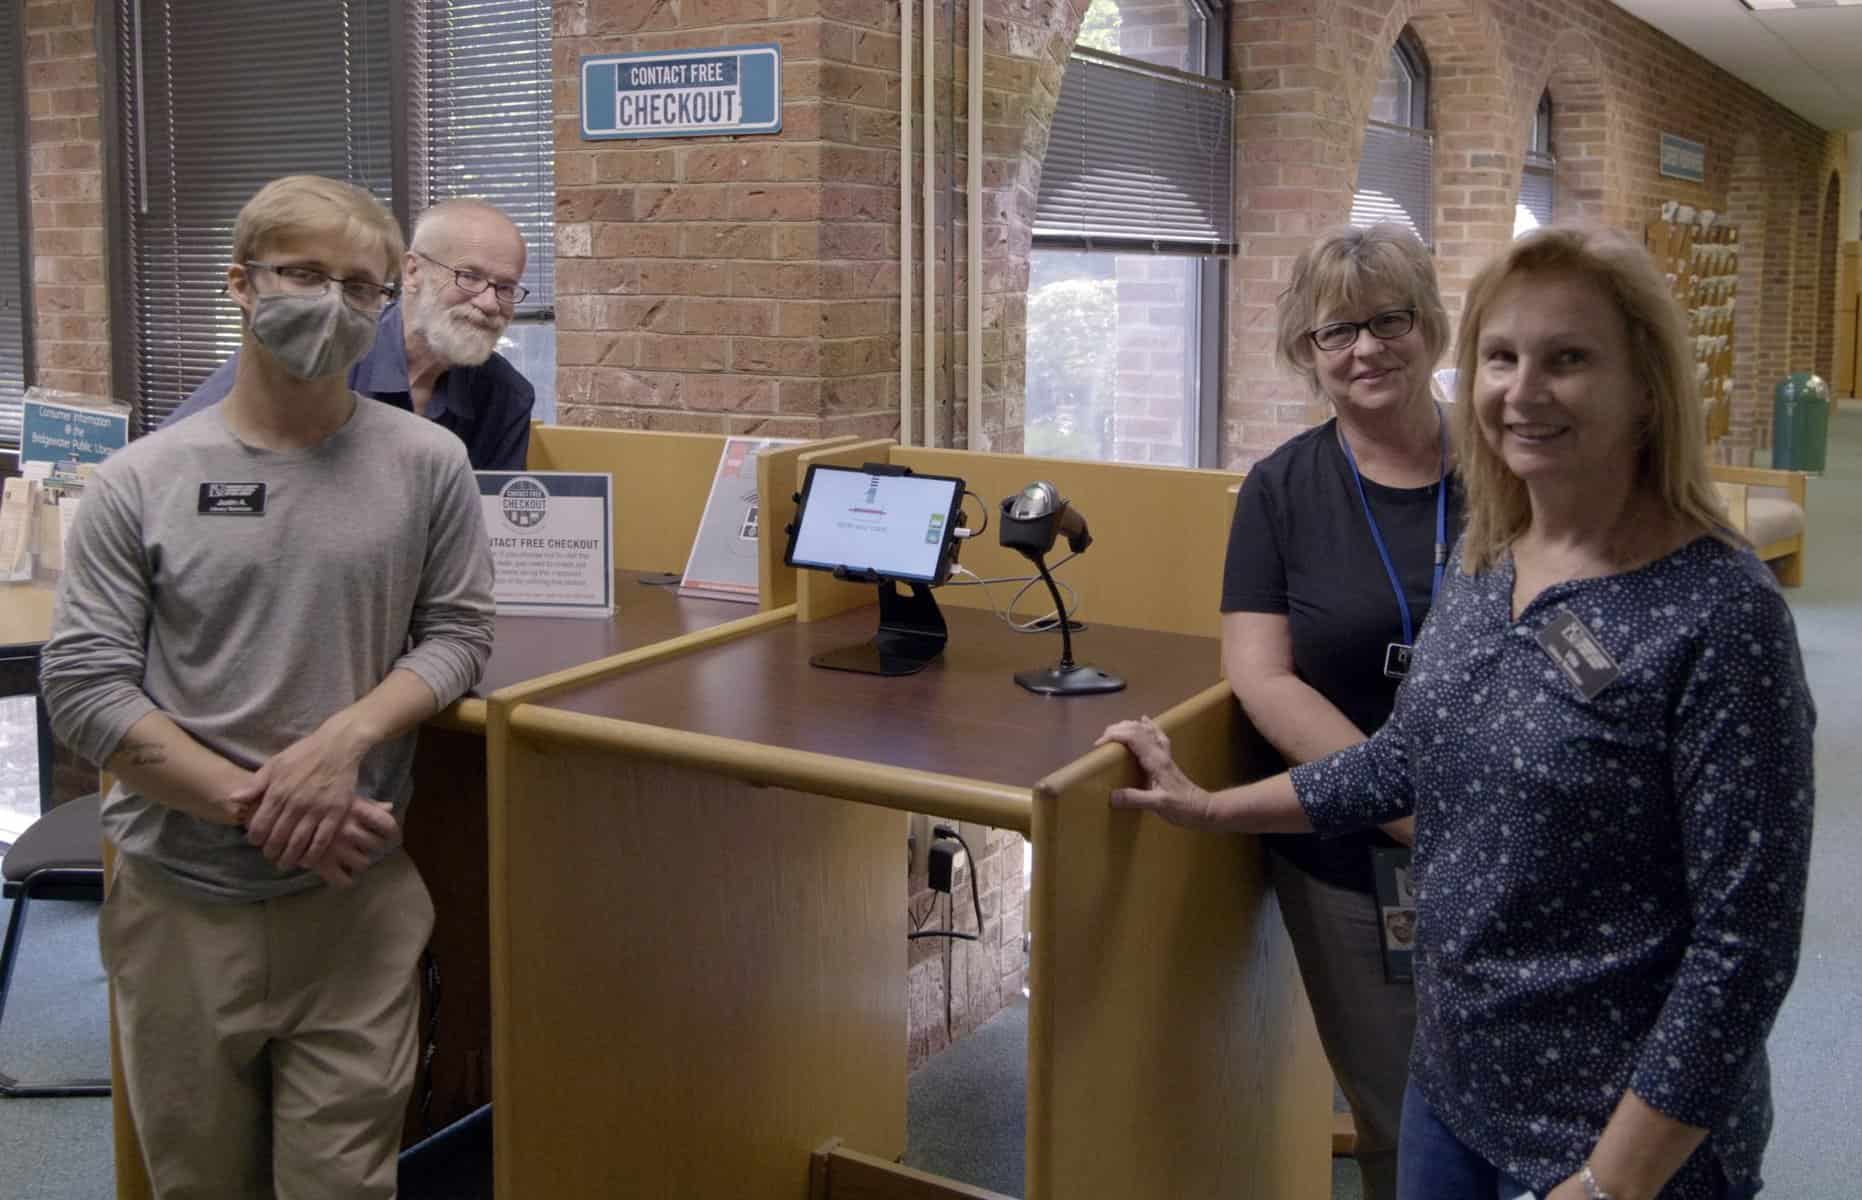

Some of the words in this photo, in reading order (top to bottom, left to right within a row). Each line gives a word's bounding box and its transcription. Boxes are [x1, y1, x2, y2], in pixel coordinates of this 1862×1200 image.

[631, 64, 687, 86] CONTACT
[690, 62, 724, 82] FREE
[620, 90, 736, 126] CHECKOUT
[40, 406, 71, 421] Consumer
[74, 414, 111, 427] Information
[73, 426, 85, 437] the
[32, 431, 70, 448] Bridgewater
[73, 440, 92, 454] Public
[503, 499, 546, 509] CHECKOUT
[520, 537, 545, 549] FREE
[547, 538, 599, 550] CHECKOUT
